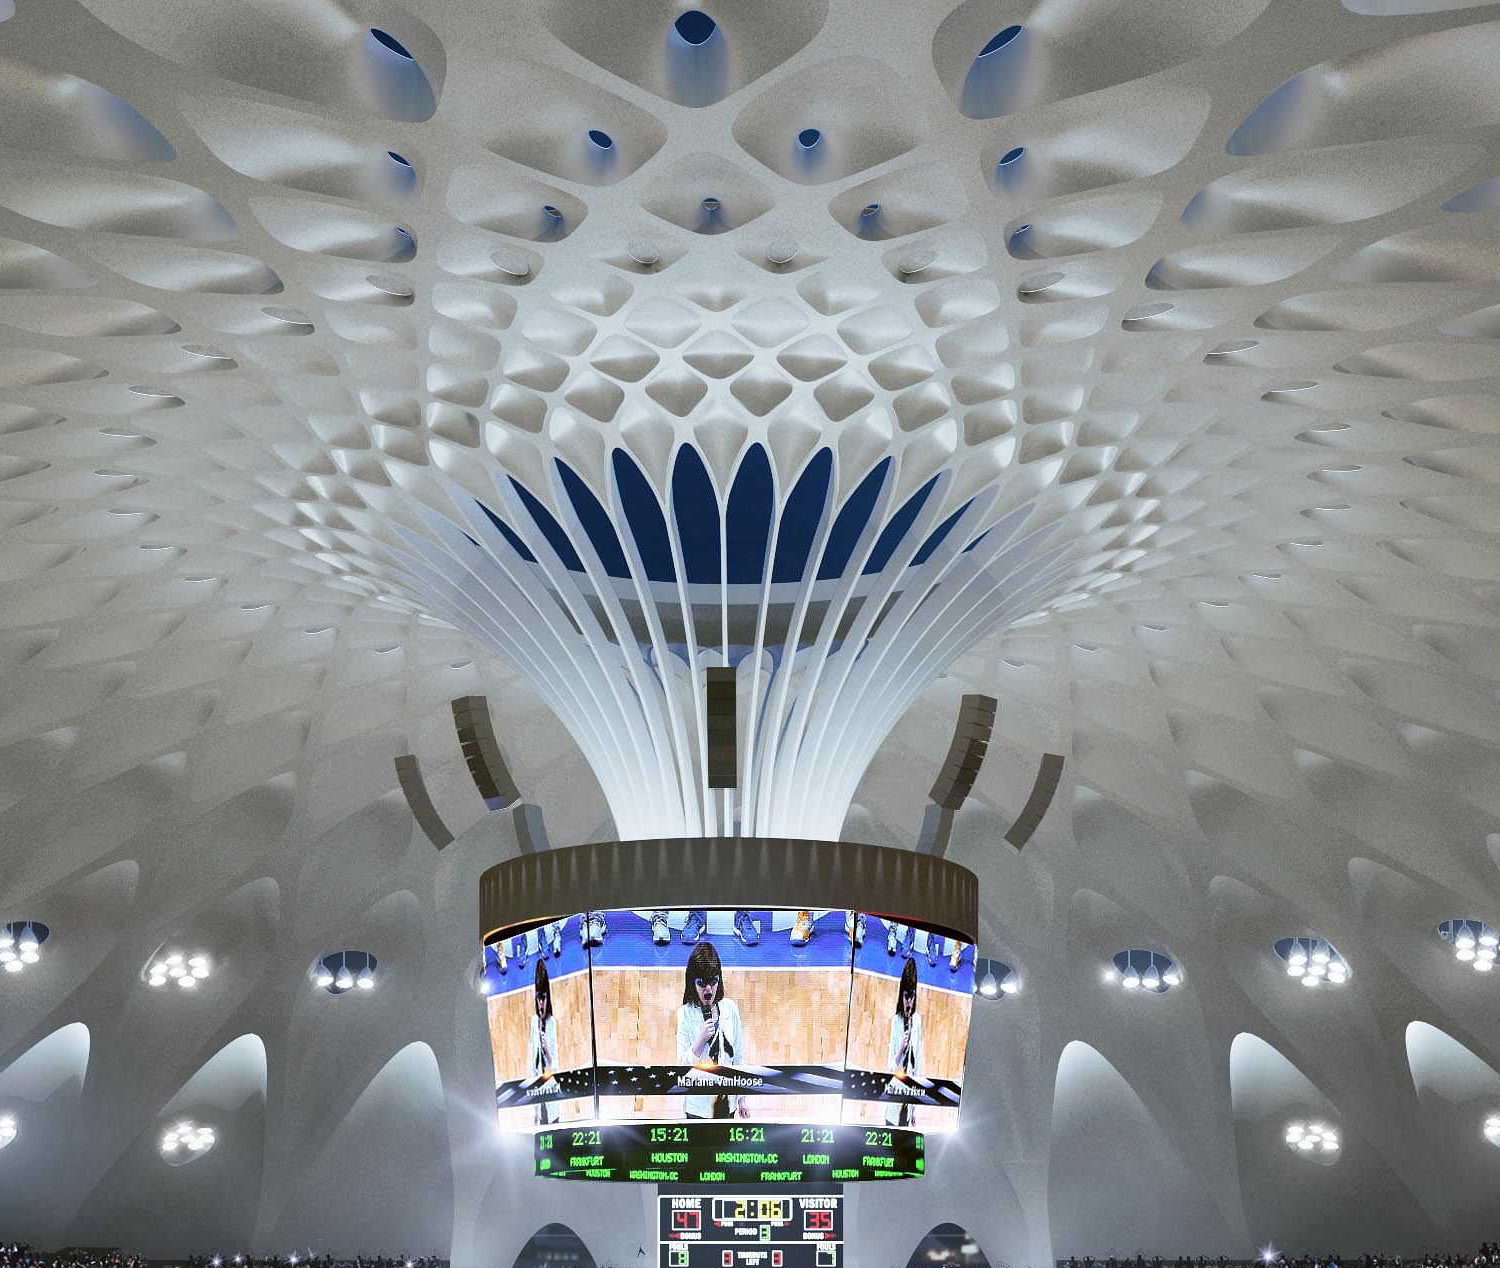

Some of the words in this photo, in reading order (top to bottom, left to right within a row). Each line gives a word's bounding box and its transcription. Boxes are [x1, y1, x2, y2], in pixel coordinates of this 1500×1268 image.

[677, 1075, 713, 1087] Mariana
[716, 1075, 763, 1087] VanHoose
[572, 1131, 601, 1146] 22:21
[651, 1128, 688, 1142] 15:21
[729, 1128, 765, 1142] 16:21
[801, 1129, 834, 1143] 21:21
[865, 1132, 892, 1146] 22:21
[570, 1156, 604, 1167] FRANKFURT
[651, 1153, 688, 1163] HOUSTON
[802, 1154, 829, 1165] LONDON
[863, 1157, 894, 1168] FRANKFURT
[700, 1172, 725, 1181] LONDON
[761, 1172, 802, 1181] FRANKFURT
[672, 1199, 701, 1208] HOME
[799, 1199, 837, 1208] VISITOR
[735, 1200, 781, 1219] 2:06
[676, 1212, 699, 1229] 47
[810, 1212, 831, 1229] 35
[680, 1232, 701, 1240] BONUS
[735, 1228, 757, 1236] PERIOD
[803, 1232, 824, 1240] BONUS
